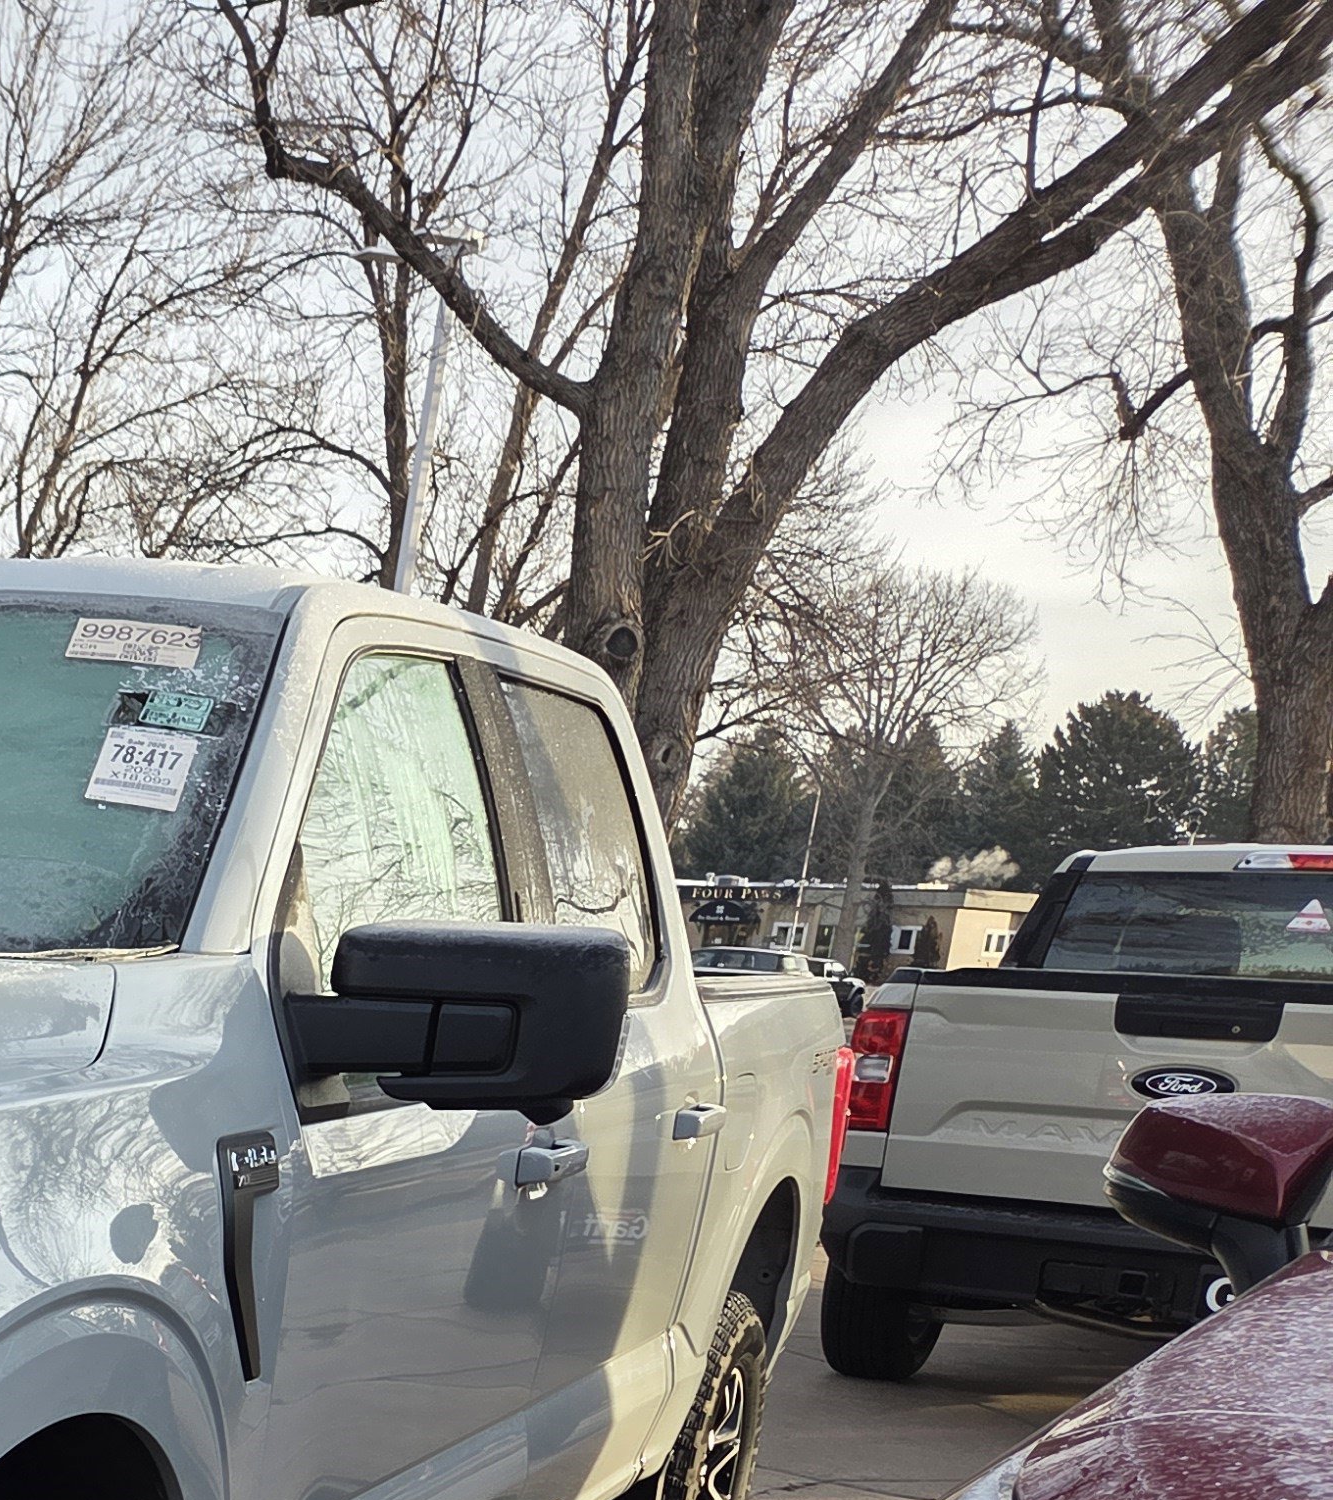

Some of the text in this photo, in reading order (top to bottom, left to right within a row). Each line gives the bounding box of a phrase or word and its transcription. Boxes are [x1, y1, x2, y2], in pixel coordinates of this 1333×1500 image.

[81, 623, 202, 649] 9987623
[110, 744, 183, 770] 78:417
[692, 887, 733, 899] FOUR
[1158, 1075, 1204, 1093] Ford
